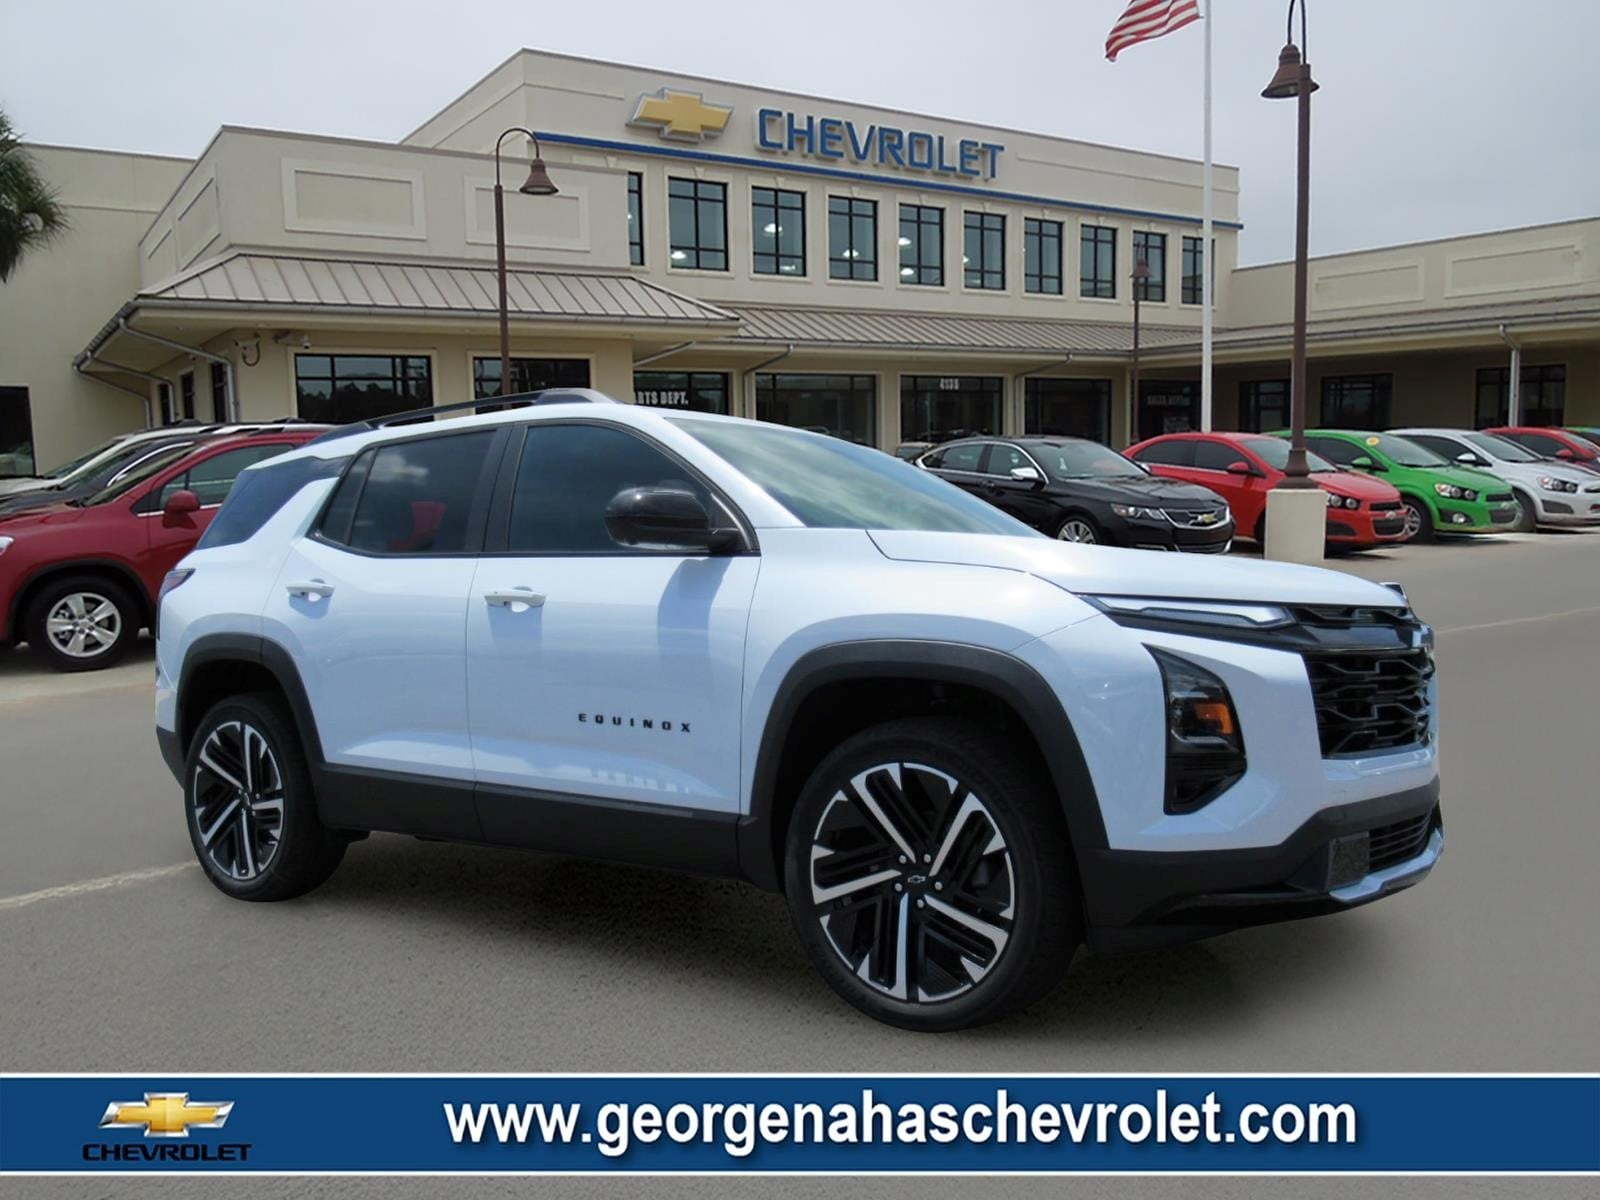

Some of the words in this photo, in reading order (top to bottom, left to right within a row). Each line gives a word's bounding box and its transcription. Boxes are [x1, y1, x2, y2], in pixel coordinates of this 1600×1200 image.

[757, 108, 1004, 179] CHEVROLET
[660, 391, 689, 405] DEPT.
[578, 713, 691, 733] EQUINOX
